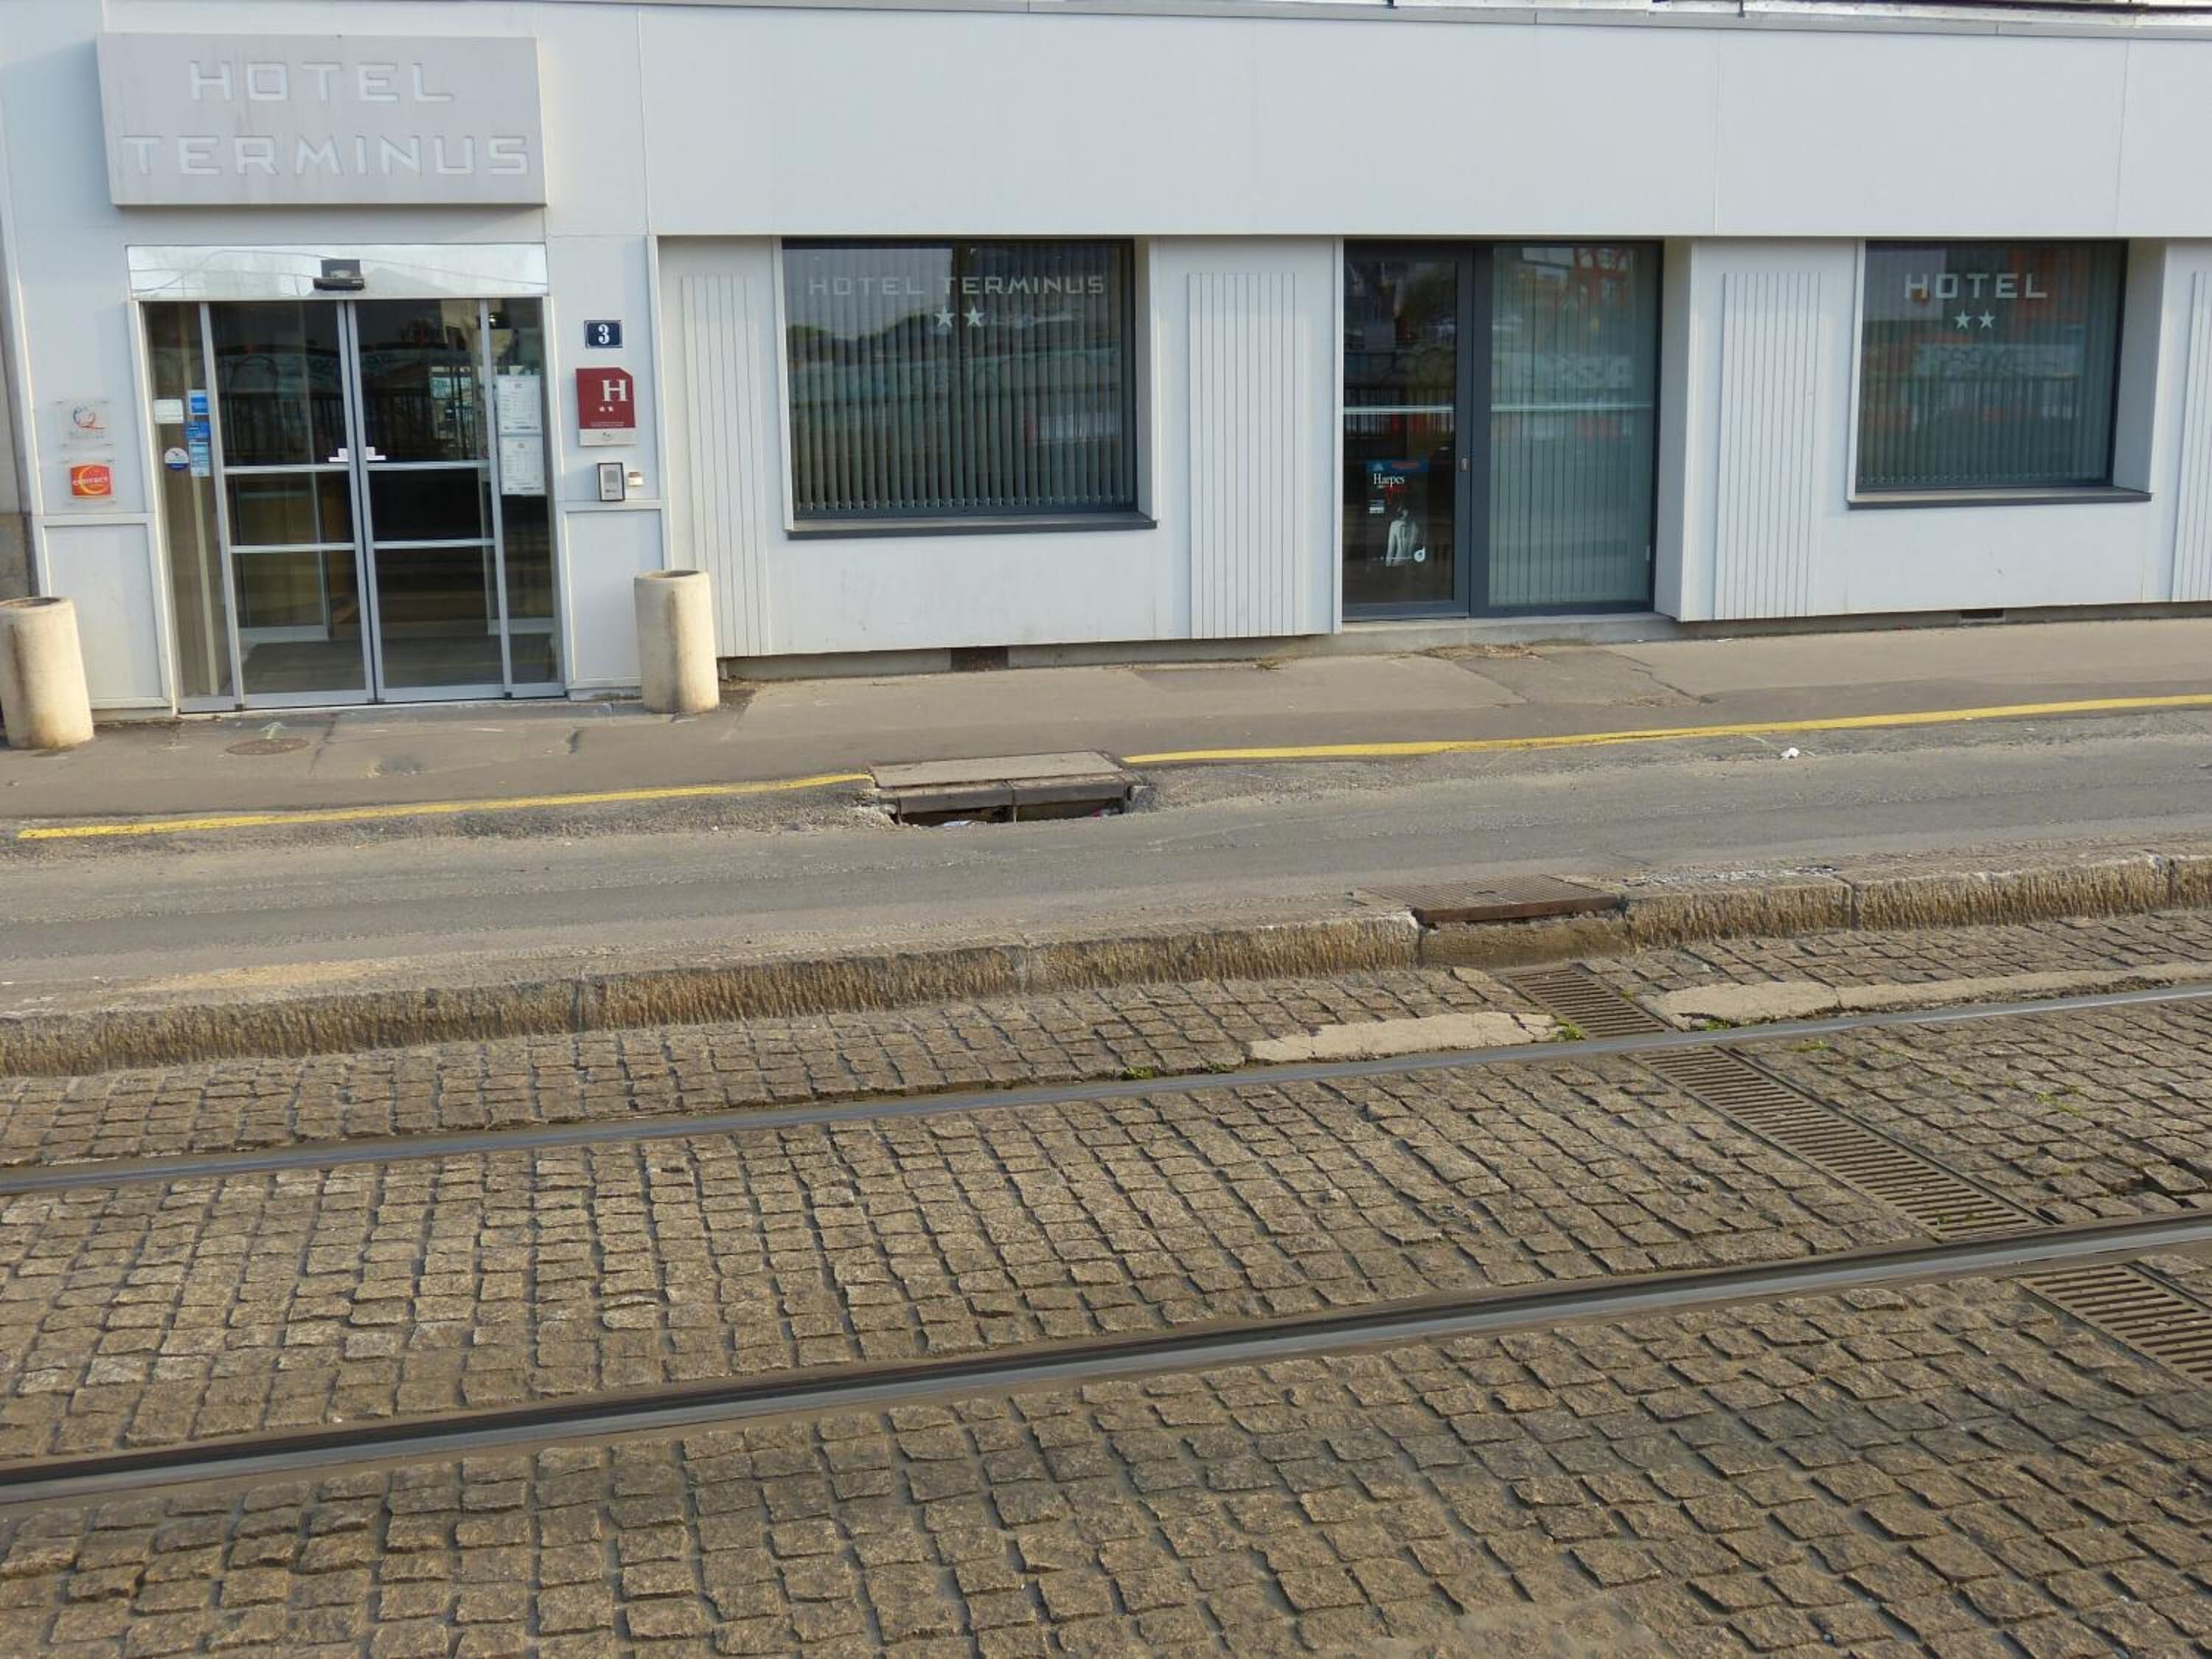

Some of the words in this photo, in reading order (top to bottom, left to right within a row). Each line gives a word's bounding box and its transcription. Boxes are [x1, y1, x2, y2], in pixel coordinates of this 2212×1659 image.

[189, 60, 455, 103] HOTEL
[118, 134, 530, 177] TERMINUS
[809, 276, 925, 296] HOTEL
[939, 275, 1105, 295] TERMINUS
[1905, 272, 2048, 299] HOTEL
[598, 324, 611, 345] 3
[602, 379, 628, 403] H
